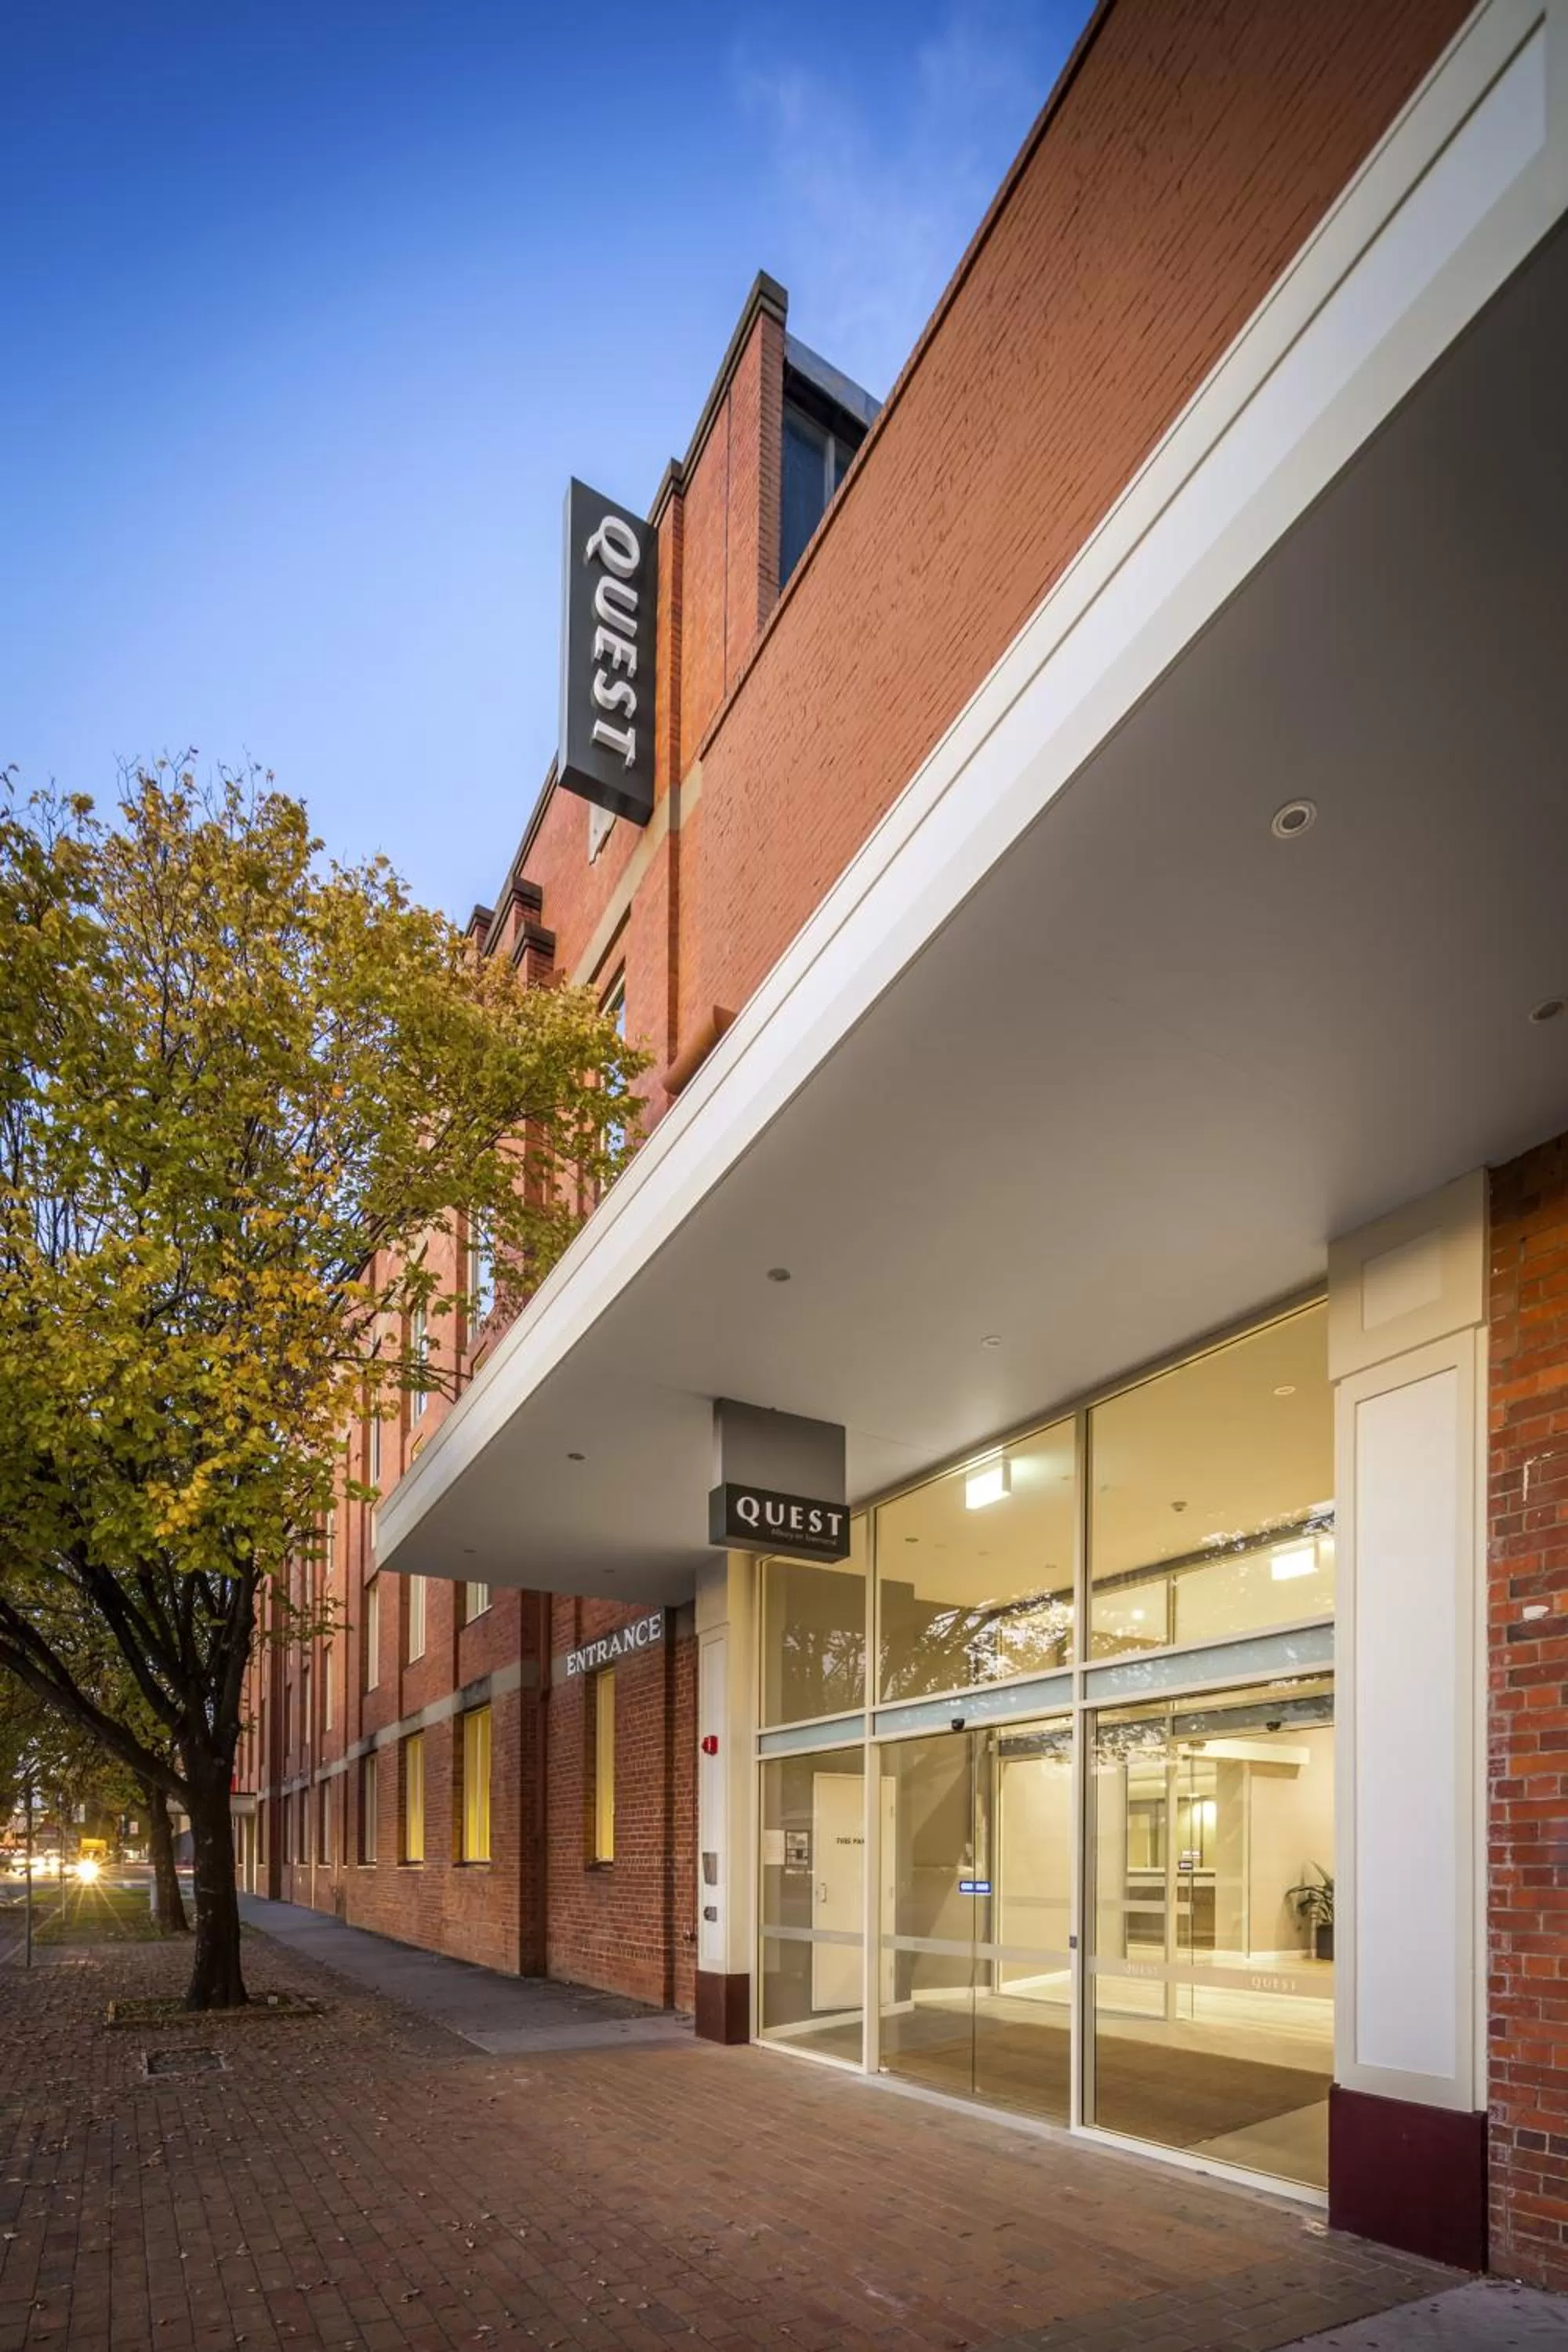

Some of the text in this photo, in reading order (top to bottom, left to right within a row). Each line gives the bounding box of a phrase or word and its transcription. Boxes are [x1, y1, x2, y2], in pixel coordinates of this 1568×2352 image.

[585, 514, 641, 768] QUEST
[735, 1496, 843, 1536] QUEST
[566, 1613, 662, 1677] ENTRANCE
[1251, 1976, 1296, 1991] QUEST
